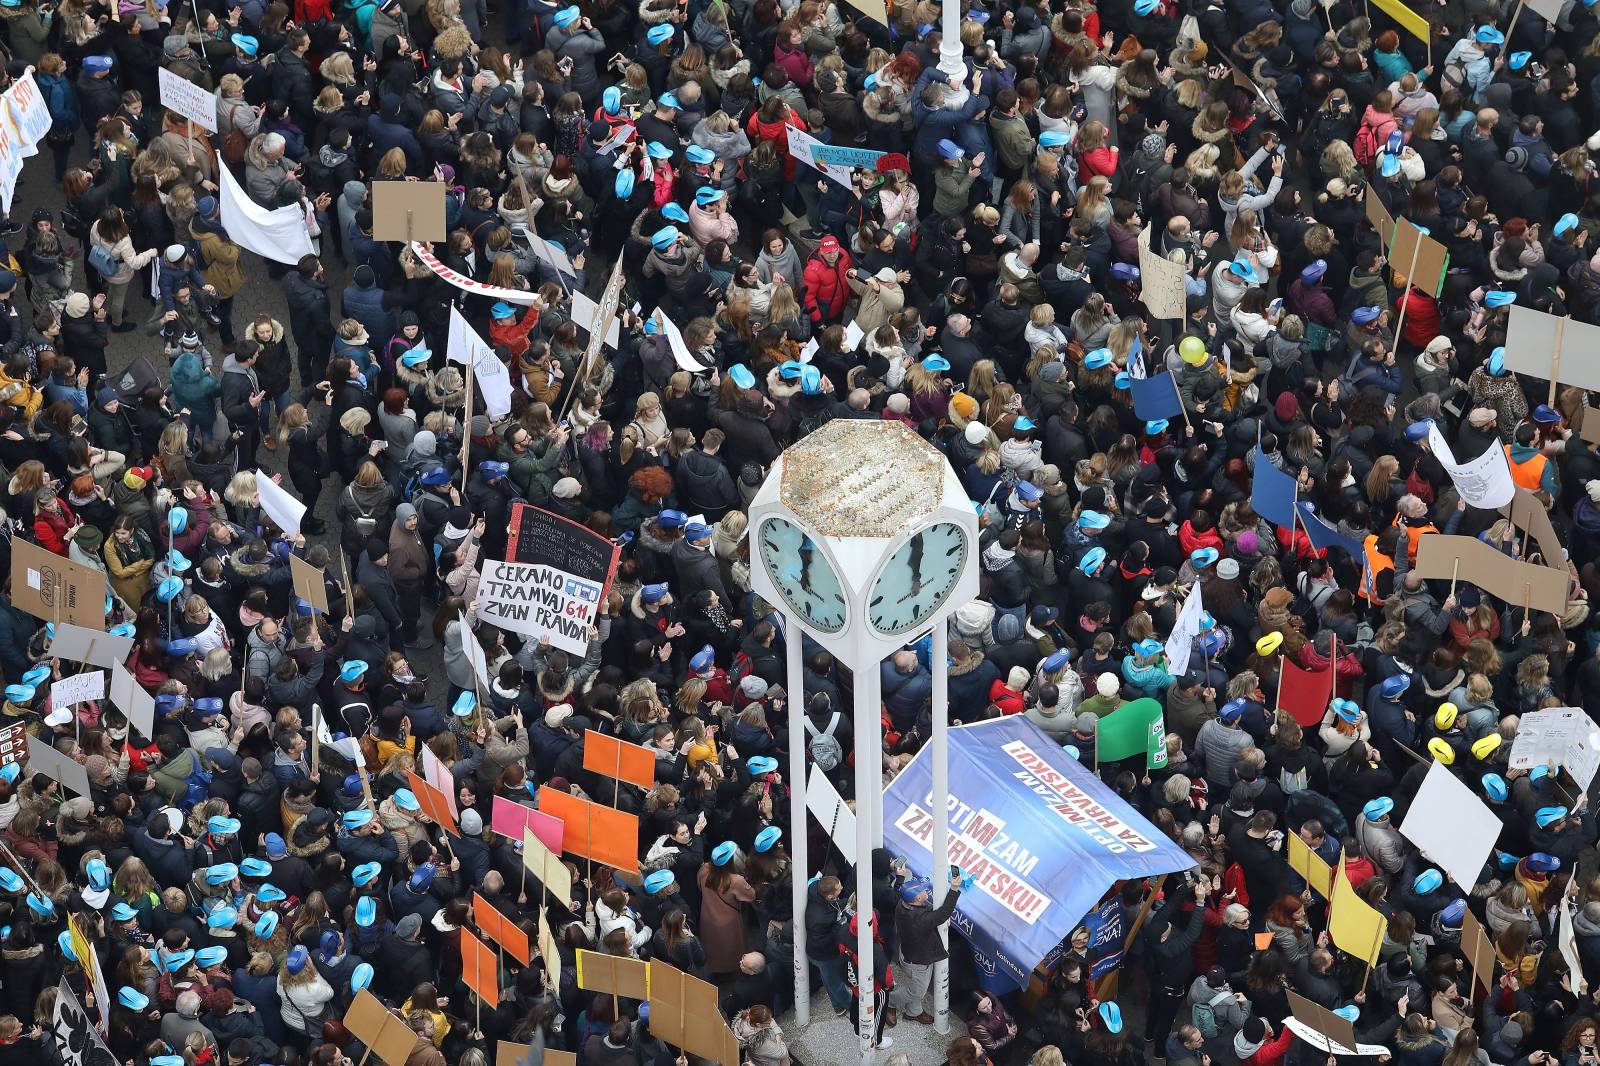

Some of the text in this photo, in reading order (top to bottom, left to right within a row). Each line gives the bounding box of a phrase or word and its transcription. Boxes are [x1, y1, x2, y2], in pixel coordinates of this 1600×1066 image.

[494, 562, 564, 591] ČEKAMO
[484, 600, 530, 621] ZVAN
[1010, 746, 1150, 849] ZA HRVATSKU!
[1013, 770, 1128, 854] OPTIMIZAM
[902, 808, 933, 841] ZA
